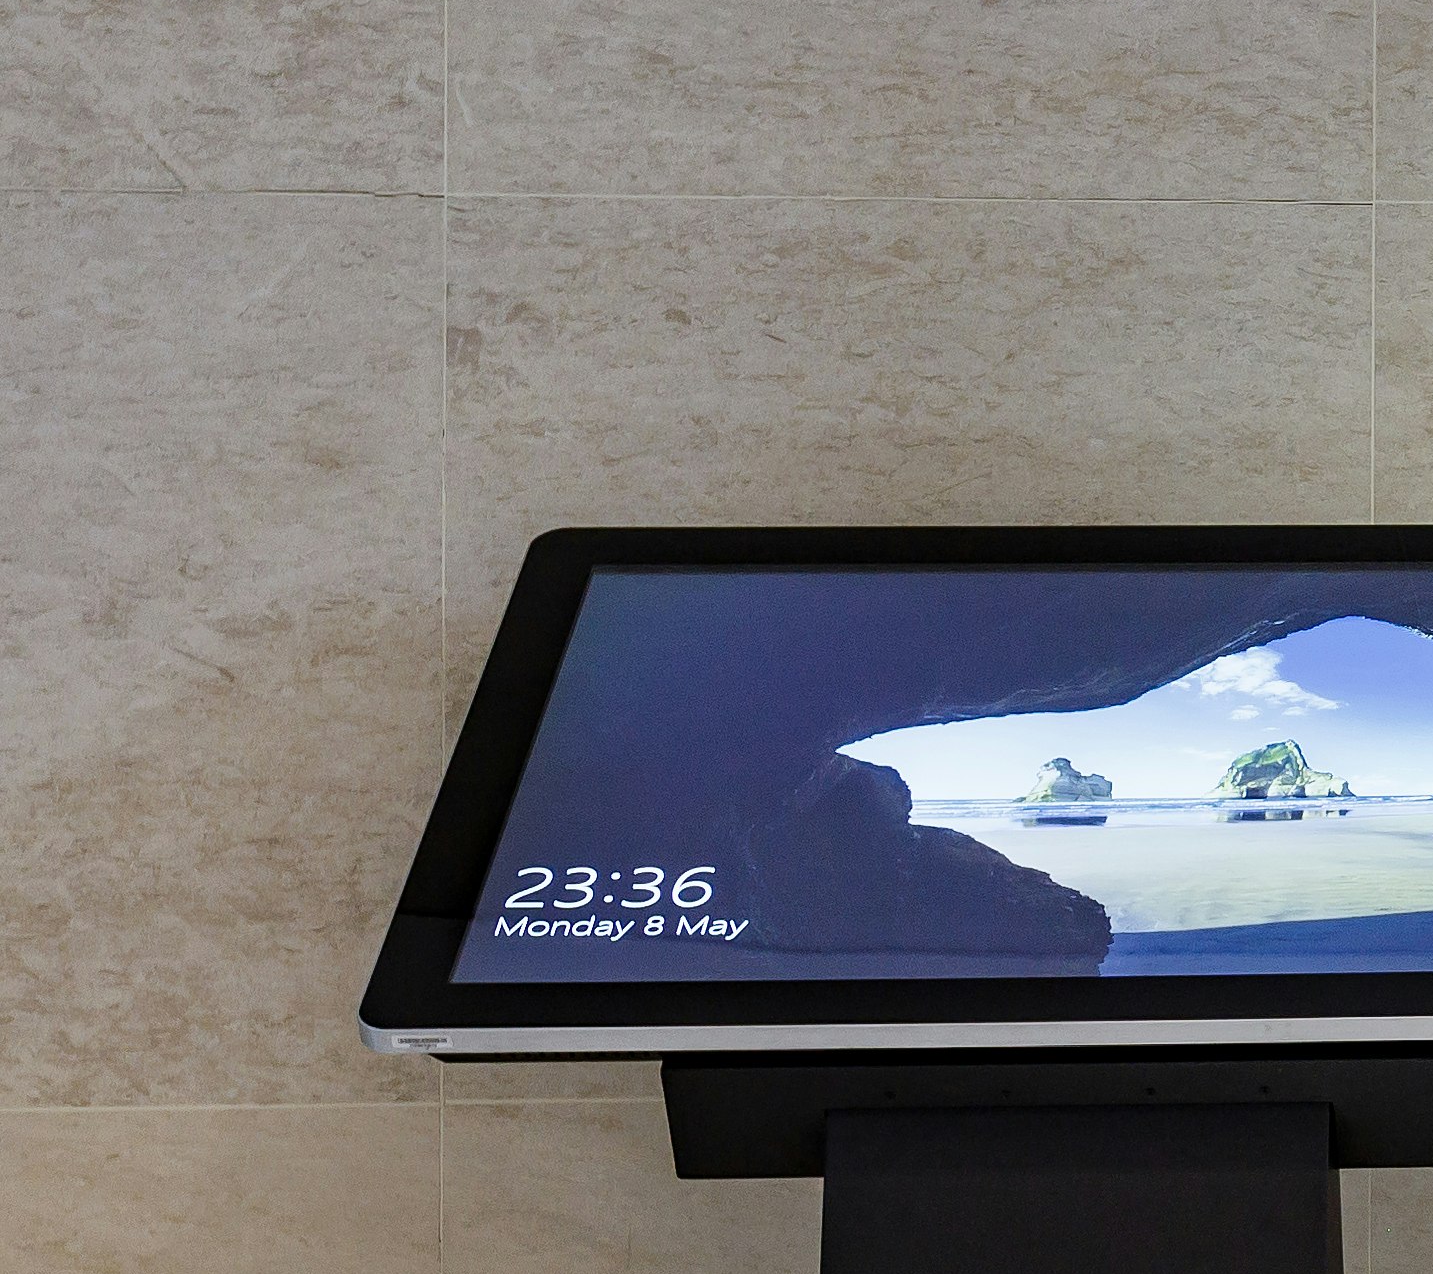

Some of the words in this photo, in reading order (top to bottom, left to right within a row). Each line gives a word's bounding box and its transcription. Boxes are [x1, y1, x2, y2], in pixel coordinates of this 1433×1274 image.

[504, 866, 716, 909] 23:36
[494, 915, 635, 942] Monday
[643, 915, 664, 936] 8
[676, 915, 749, 941] May
